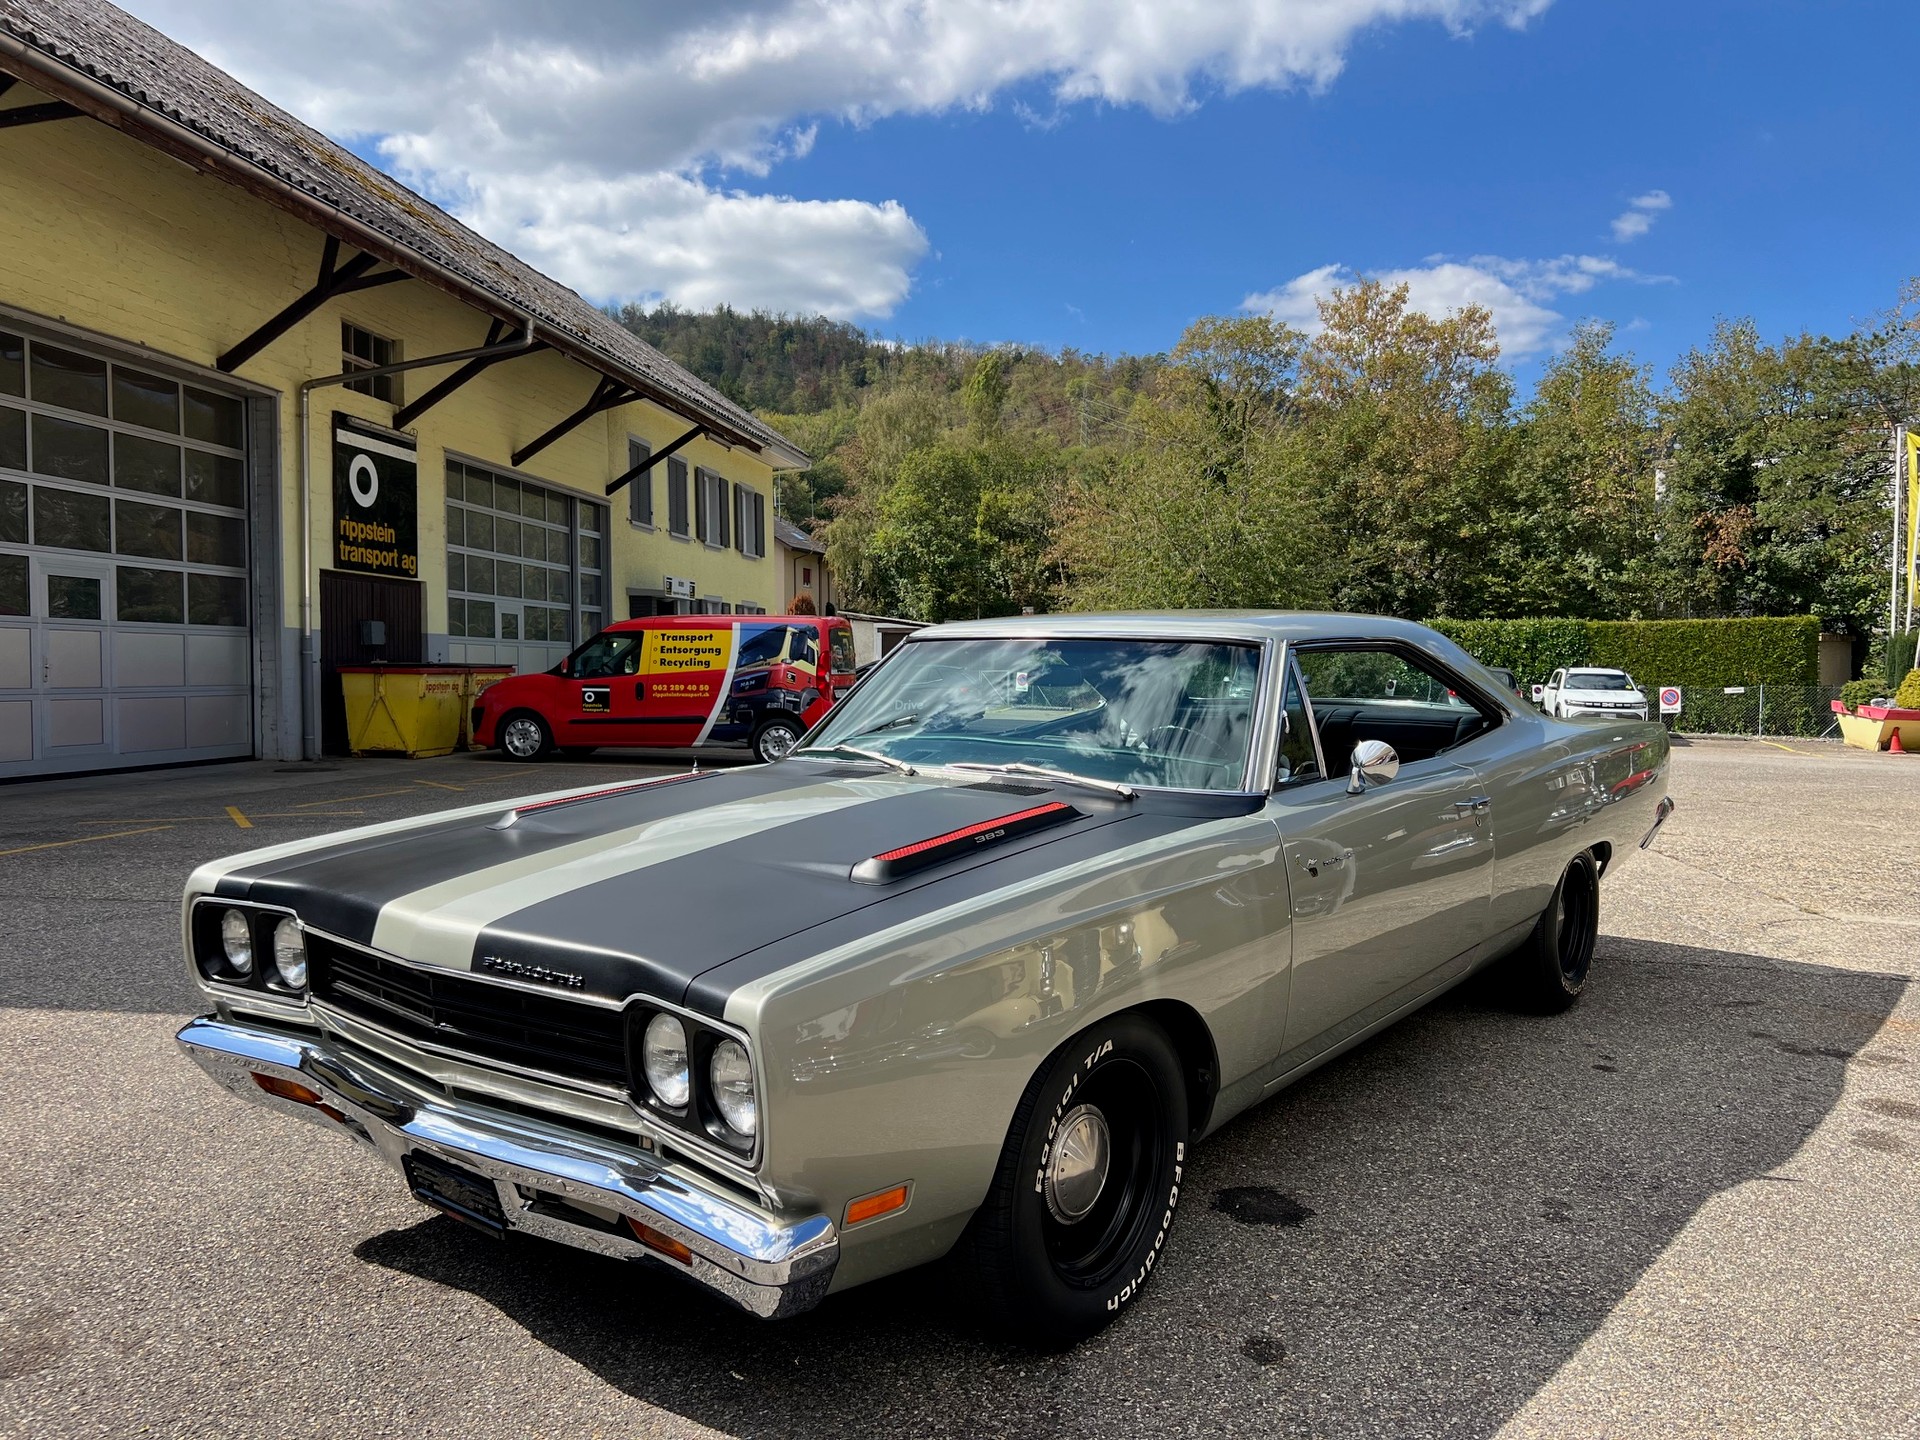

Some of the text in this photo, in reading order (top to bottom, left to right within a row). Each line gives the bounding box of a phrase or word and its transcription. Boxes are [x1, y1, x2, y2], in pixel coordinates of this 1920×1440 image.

[340, 515, 395, 543] rippstein
[340, 540, 416, 574] transport ag
[660, 633, 713, 643] Transport
[660, 646, 721, 656] Entsorgung
[660, 658, 710, 668] Recycling
[974, 829, 1005, 844] 383
[483, 955, 585, 986] PLYMOUTH
[1035, 1039, 1114, 1193] Radial T/A
[1107, 1142, 1184, 1311] BFGoodrich
